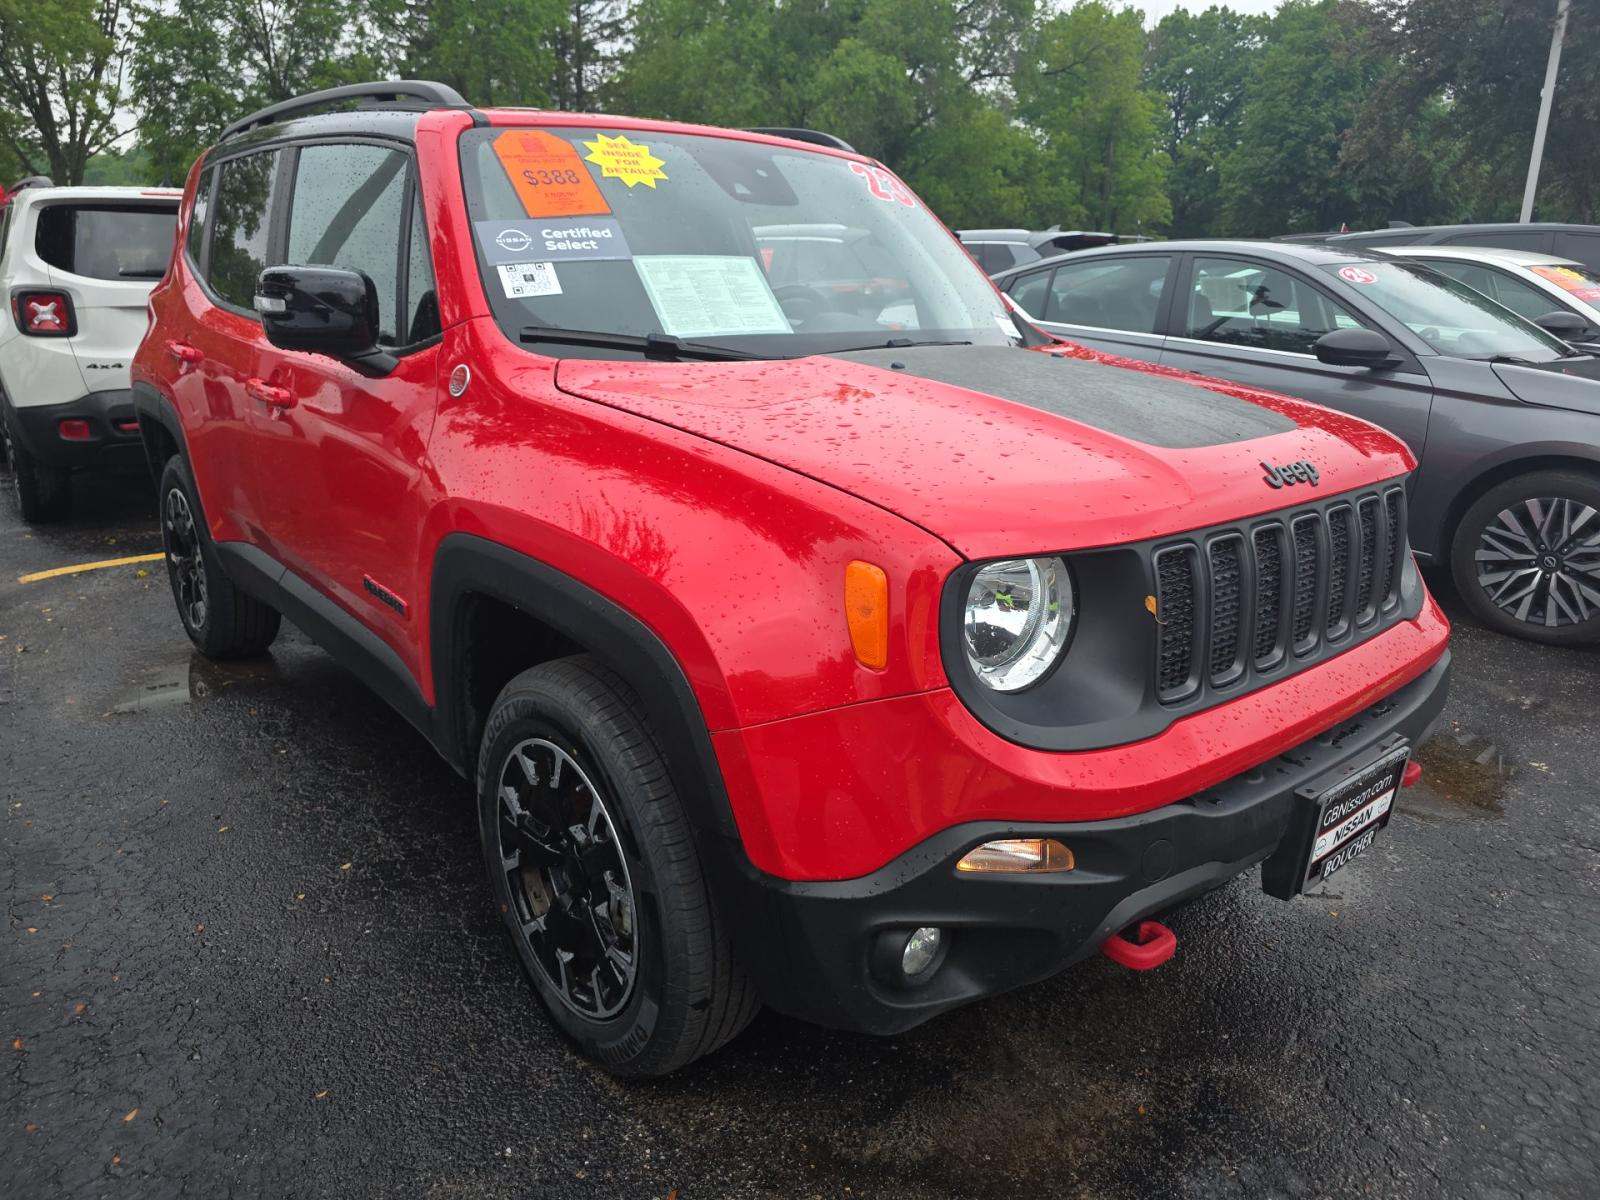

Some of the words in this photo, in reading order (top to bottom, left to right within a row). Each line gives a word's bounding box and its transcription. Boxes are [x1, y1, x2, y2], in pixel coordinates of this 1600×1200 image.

[606, 141, 628, 150] SEE
[601, 150, 645, 159] INSIDE
[523, 169, 580, 187] $388
[541, 226, 613, 240] Certified
[544, 239, 599, 251] Select
[86, 362, 124, 370] 4x4
[1259, 459, 1320, 490] Jeep
[1322, 774, 1393, 827] GBNissan.com
[1332, 806, 1375, 845] NISSAN
[1322, 829, 1376, 878] BOUCHER
